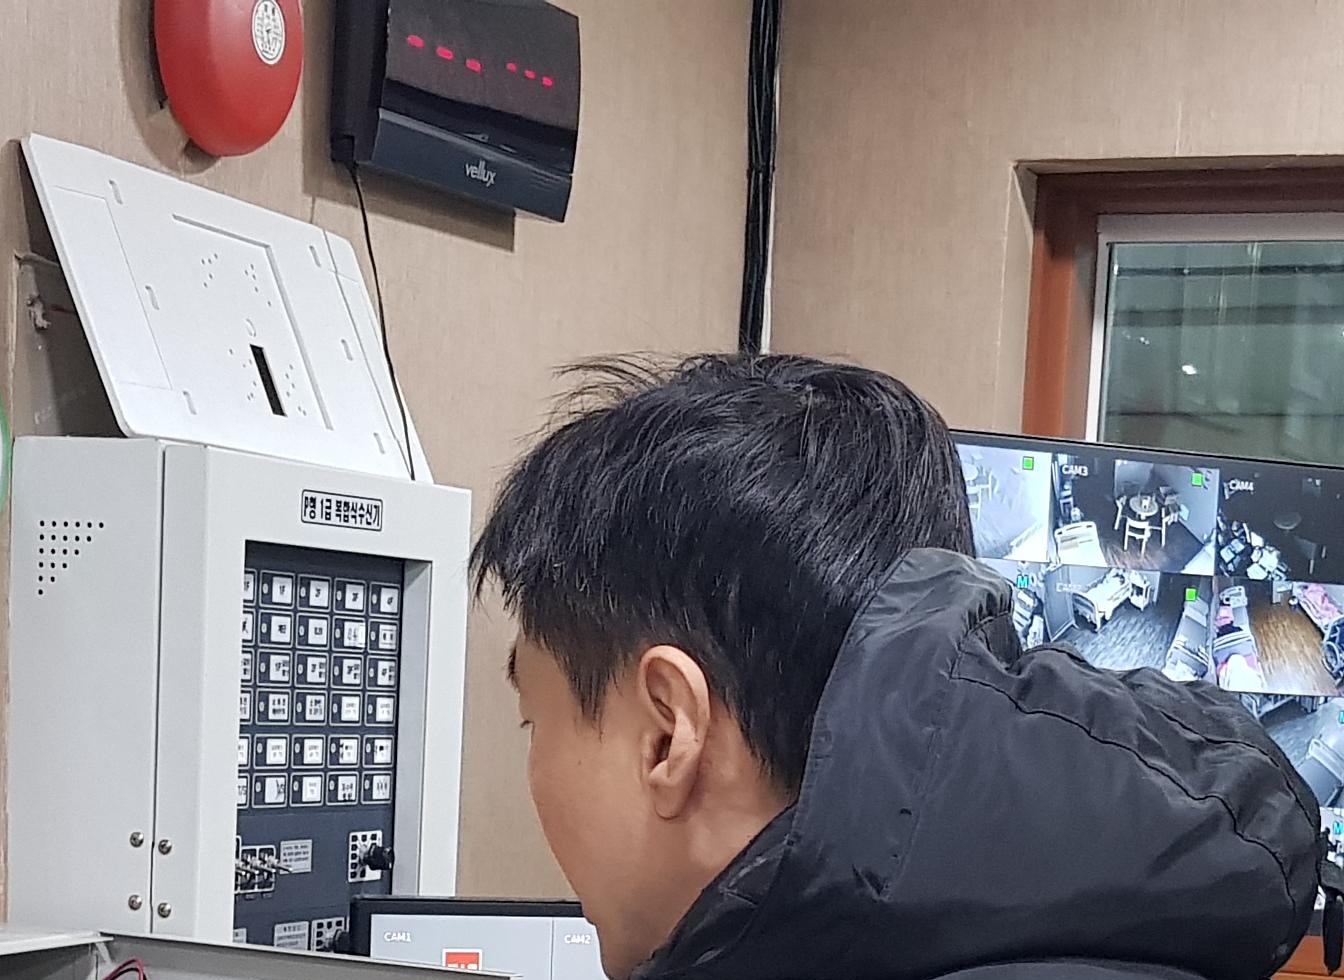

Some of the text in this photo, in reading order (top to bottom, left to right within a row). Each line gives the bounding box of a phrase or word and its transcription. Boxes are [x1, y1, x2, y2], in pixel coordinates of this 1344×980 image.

[465, 160, 497, 187] vellux
[1061, 464, 1089, 477] CAM3
[1229, 479, 1254, 492] CAM4
[384, 931, 412, 943] CAM1
[564, 933, 591, 945] CAM2
